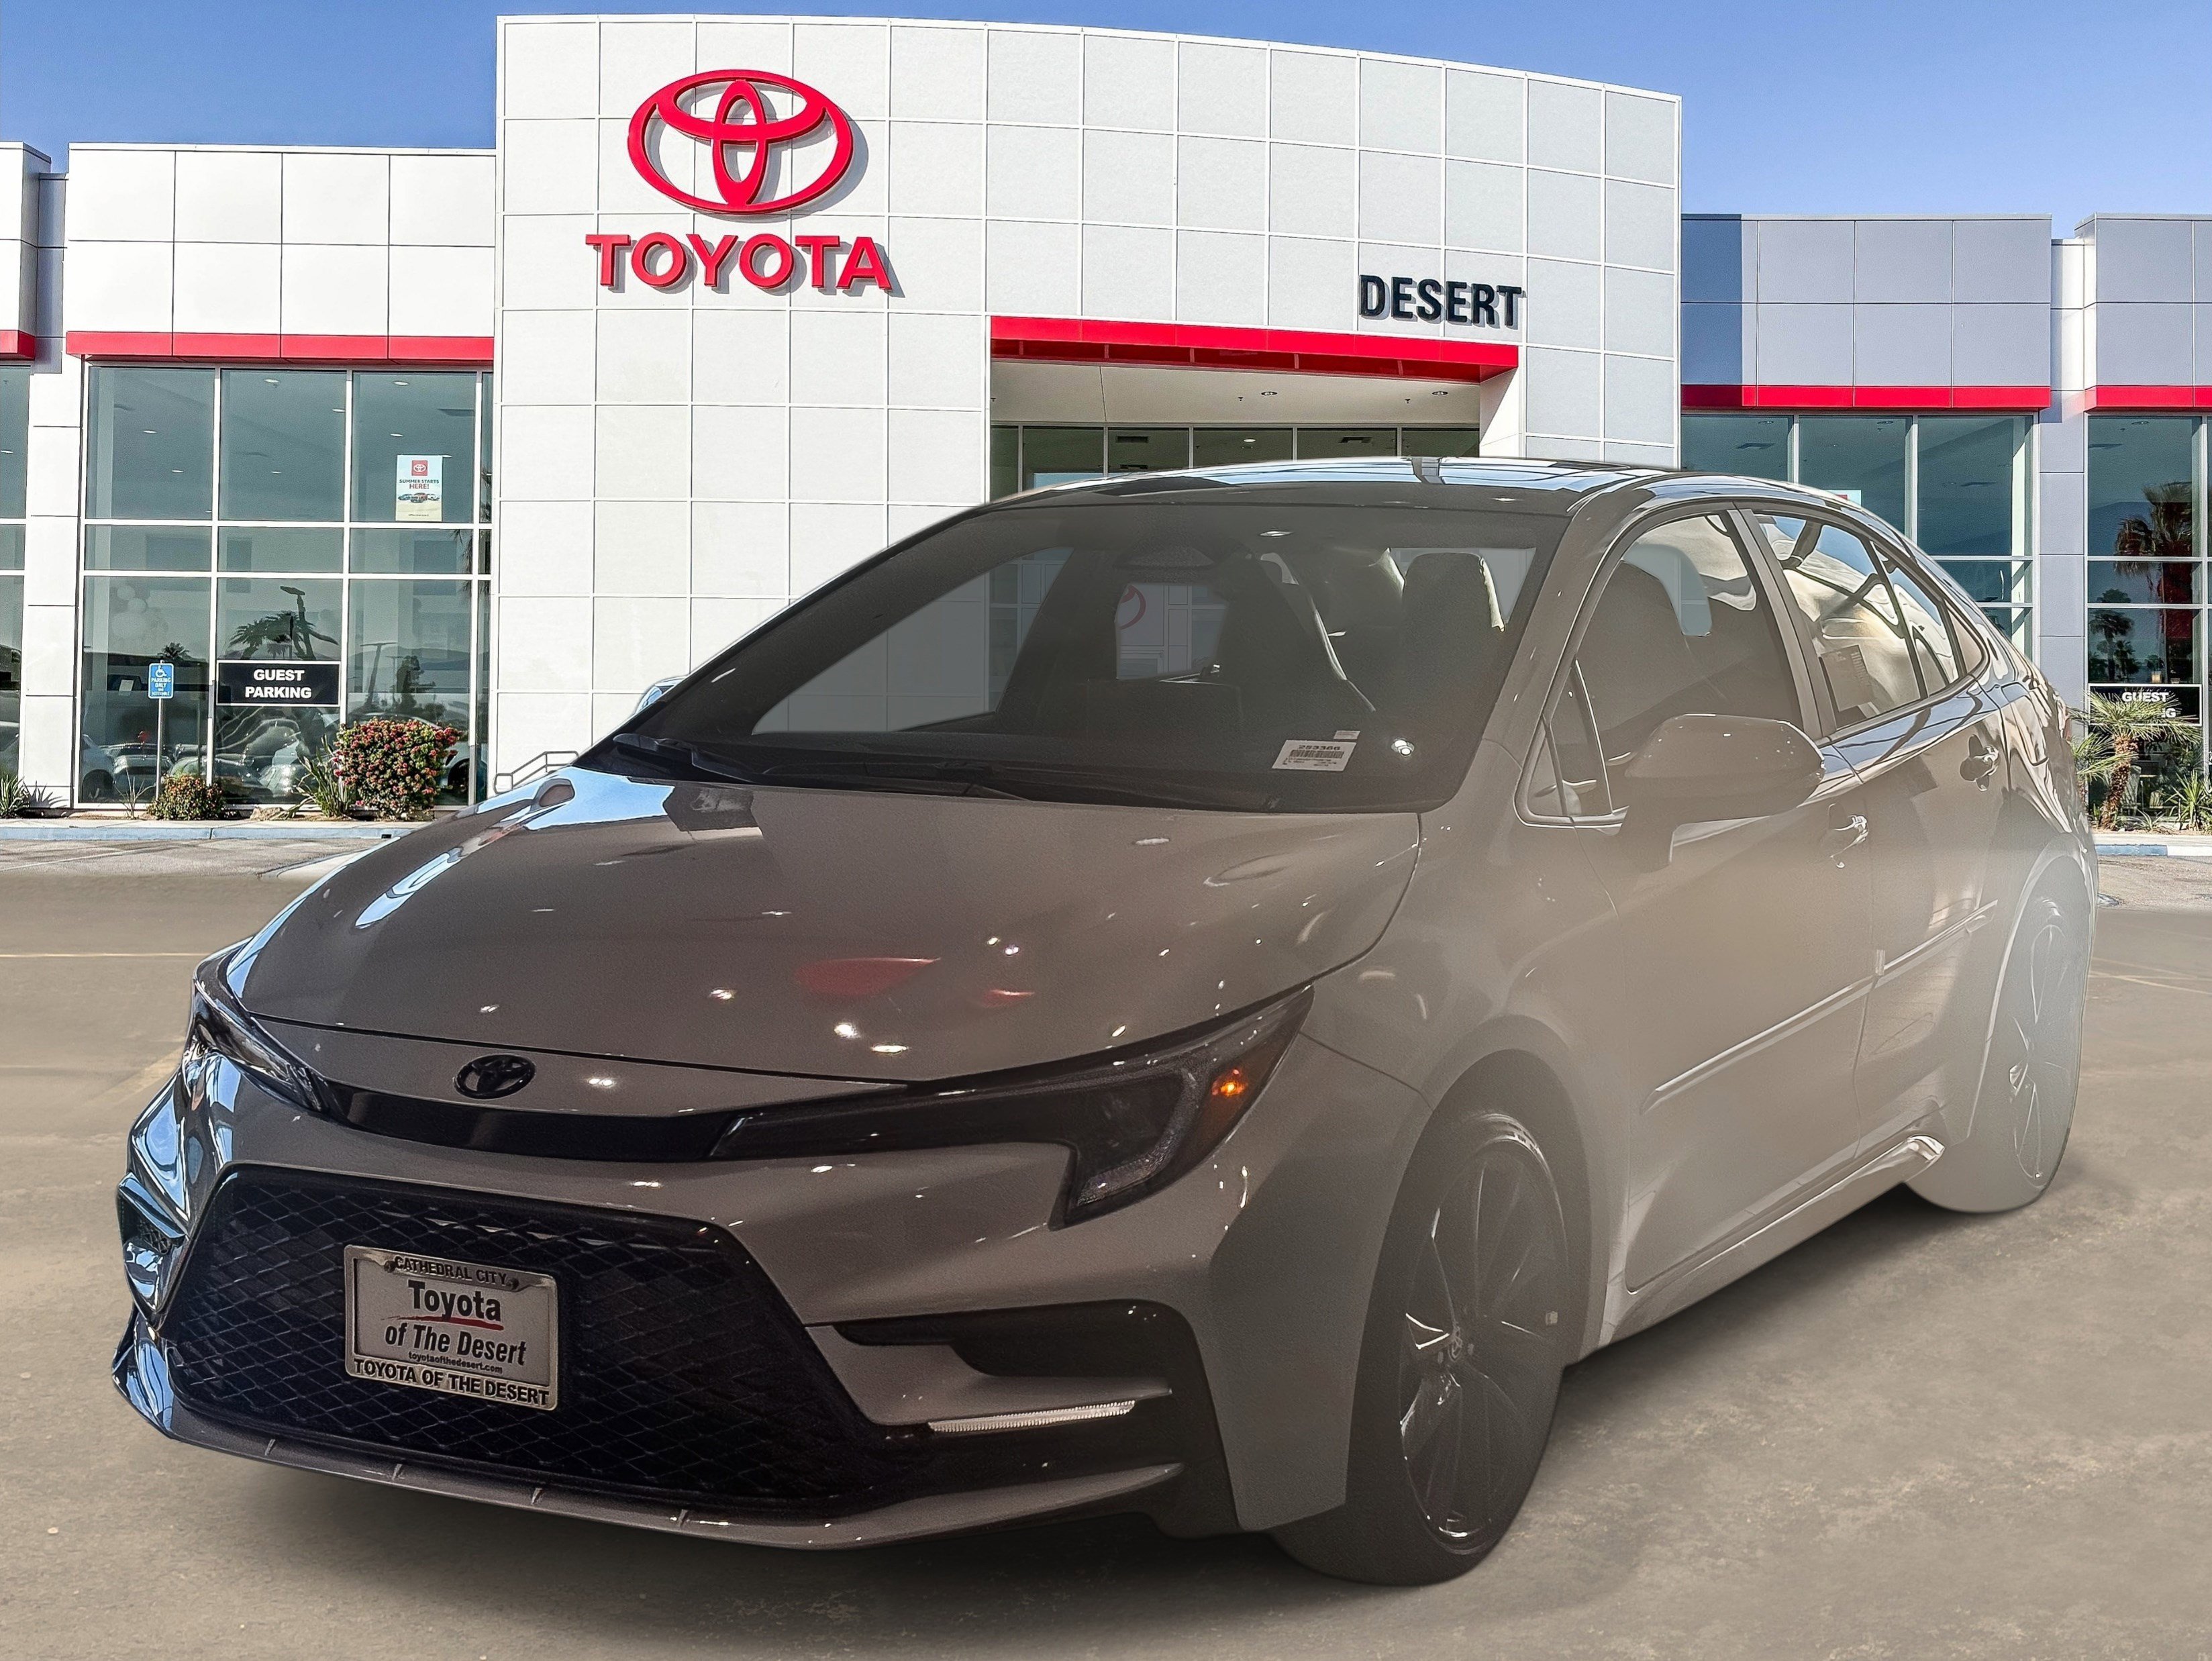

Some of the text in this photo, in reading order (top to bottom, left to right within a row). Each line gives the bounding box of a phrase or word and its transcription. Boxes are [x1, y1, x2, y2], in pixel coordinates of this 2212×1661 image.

[586, 232, 893, 290] TOYOTA
[1359, 274, 1522, 327] DESERT
[245, 686, 312, 699] PARKING
[253, 669, 305, 681] GUEST
[2122, 691, 2170, 703] GUEST
[395, 1256, 508, 1286] CATHEDRAL CITY
[408, 1279, 501, 1322] Toyota
[385, 1323, 527, 1366] of The Desert
[408, 1352, 503, 1374] toyotaofthedesert.com
[354, 1358, 550, 1406] TOYOTA OF THE DESERT
